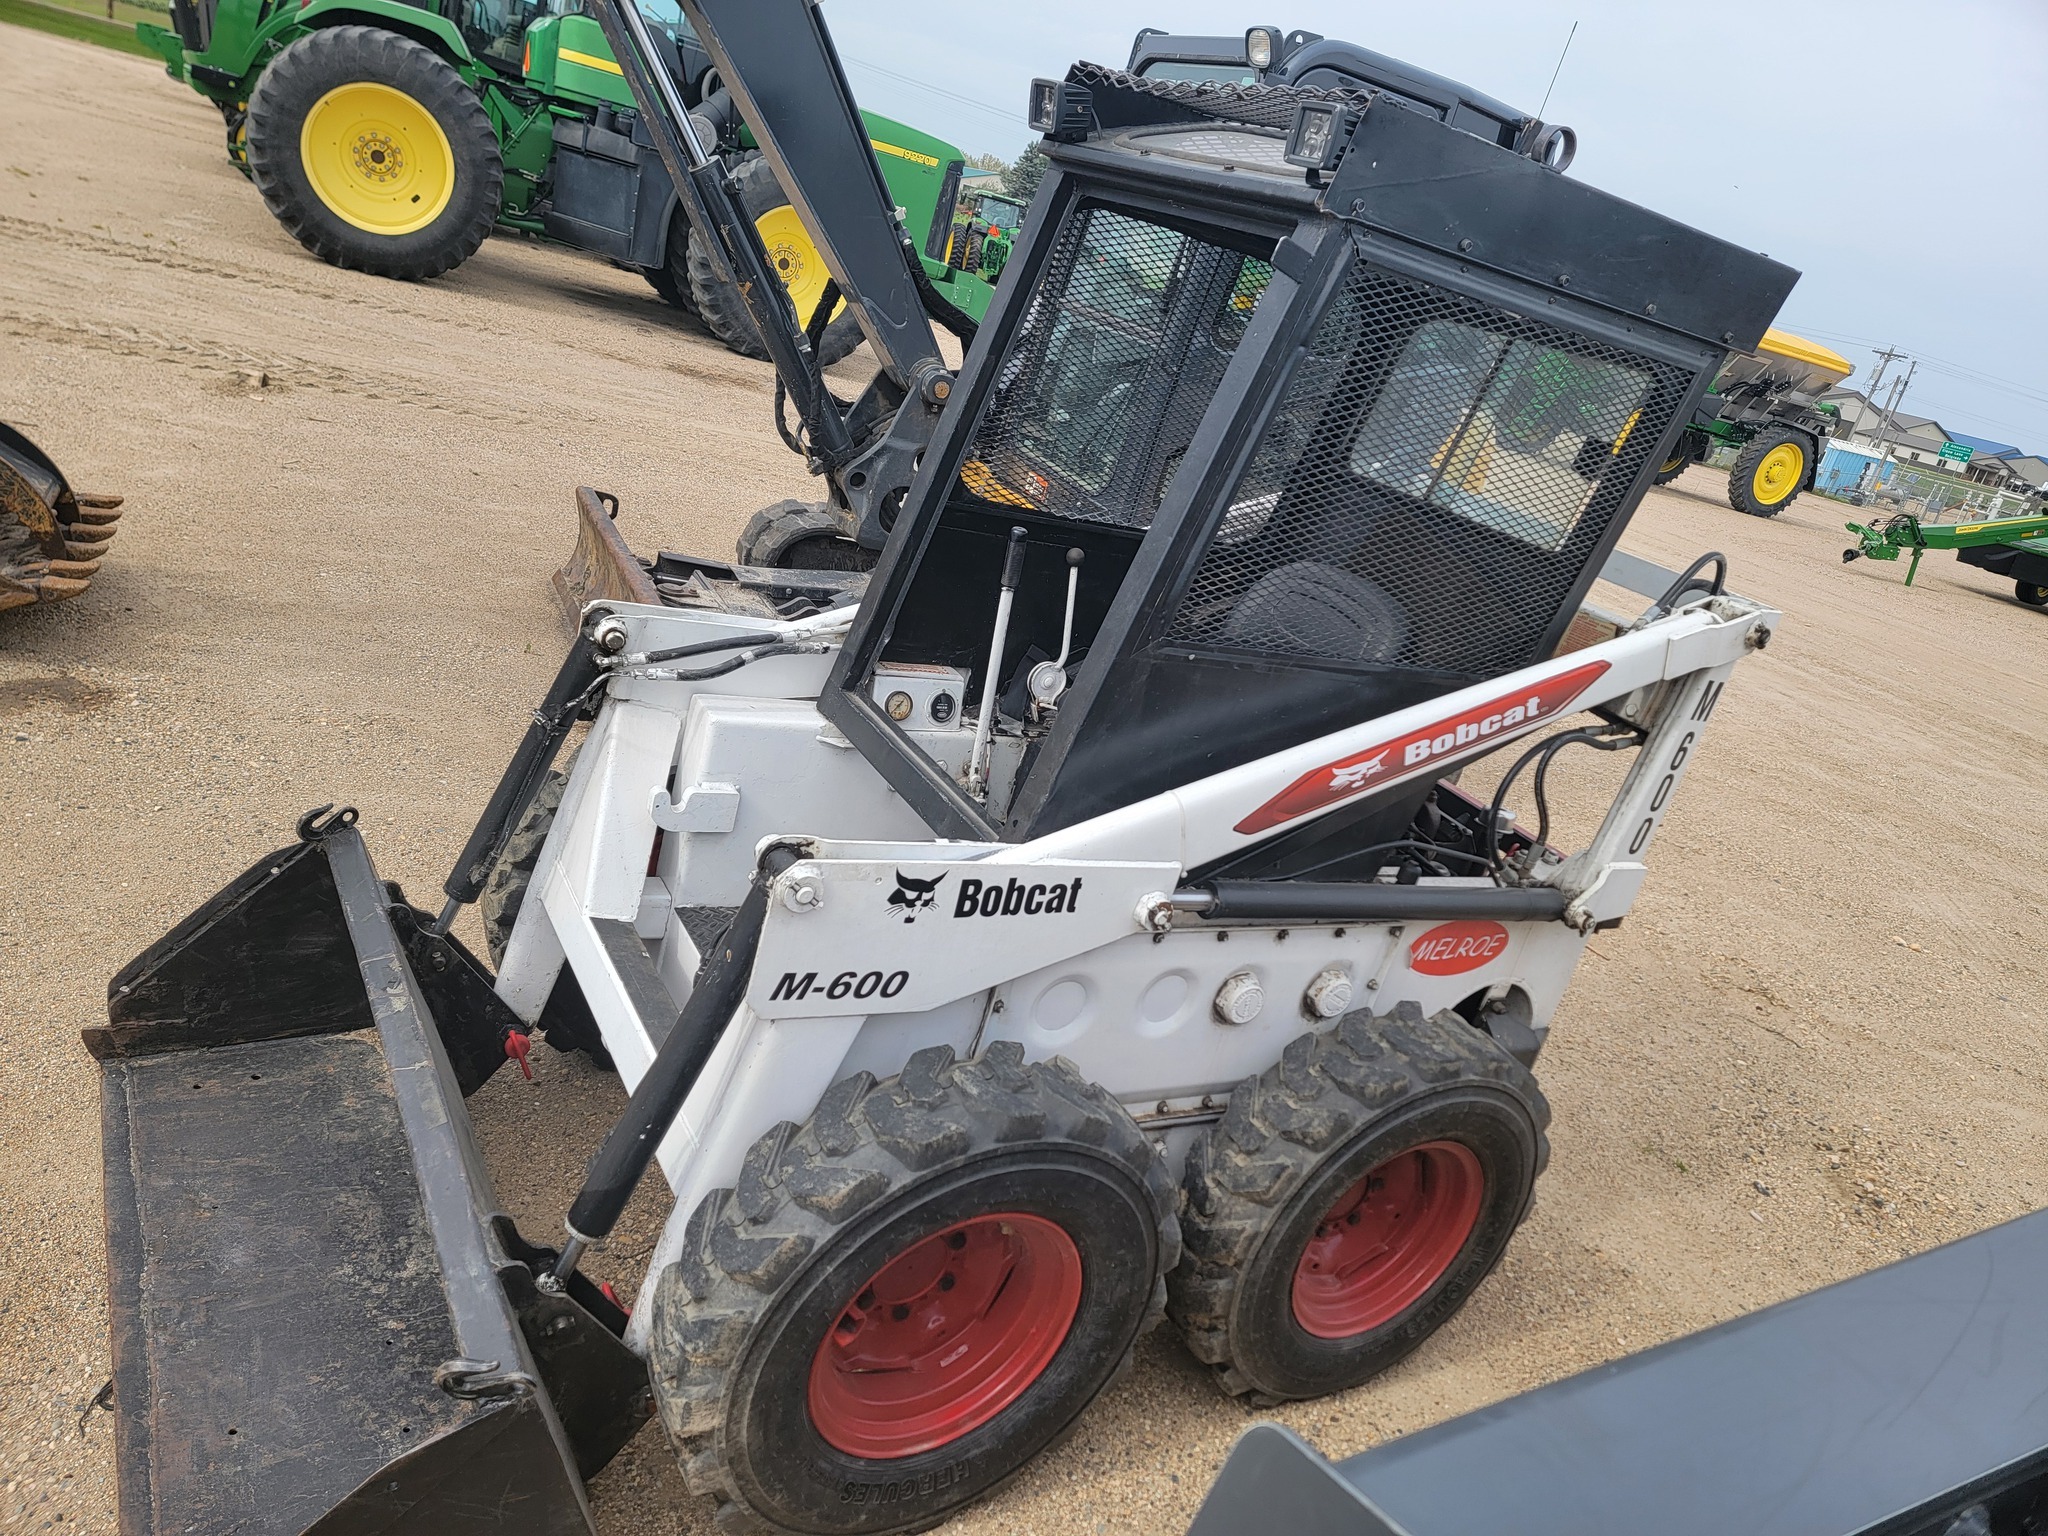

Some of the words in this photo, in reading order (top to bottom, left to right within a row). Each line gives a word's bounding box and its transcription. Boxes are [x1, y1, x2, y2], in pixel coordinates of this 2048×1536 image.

[903, 150, 931, 166] 9220
[1404, 696, 1541, 767] Bobcat
[953, 876, 1084, 918] Bobcat
[1413, 933, 1506, 961] MELROE
[768, 970, 910, 1001] M-600
[840, 1459, 971, 1505] HERCULES
